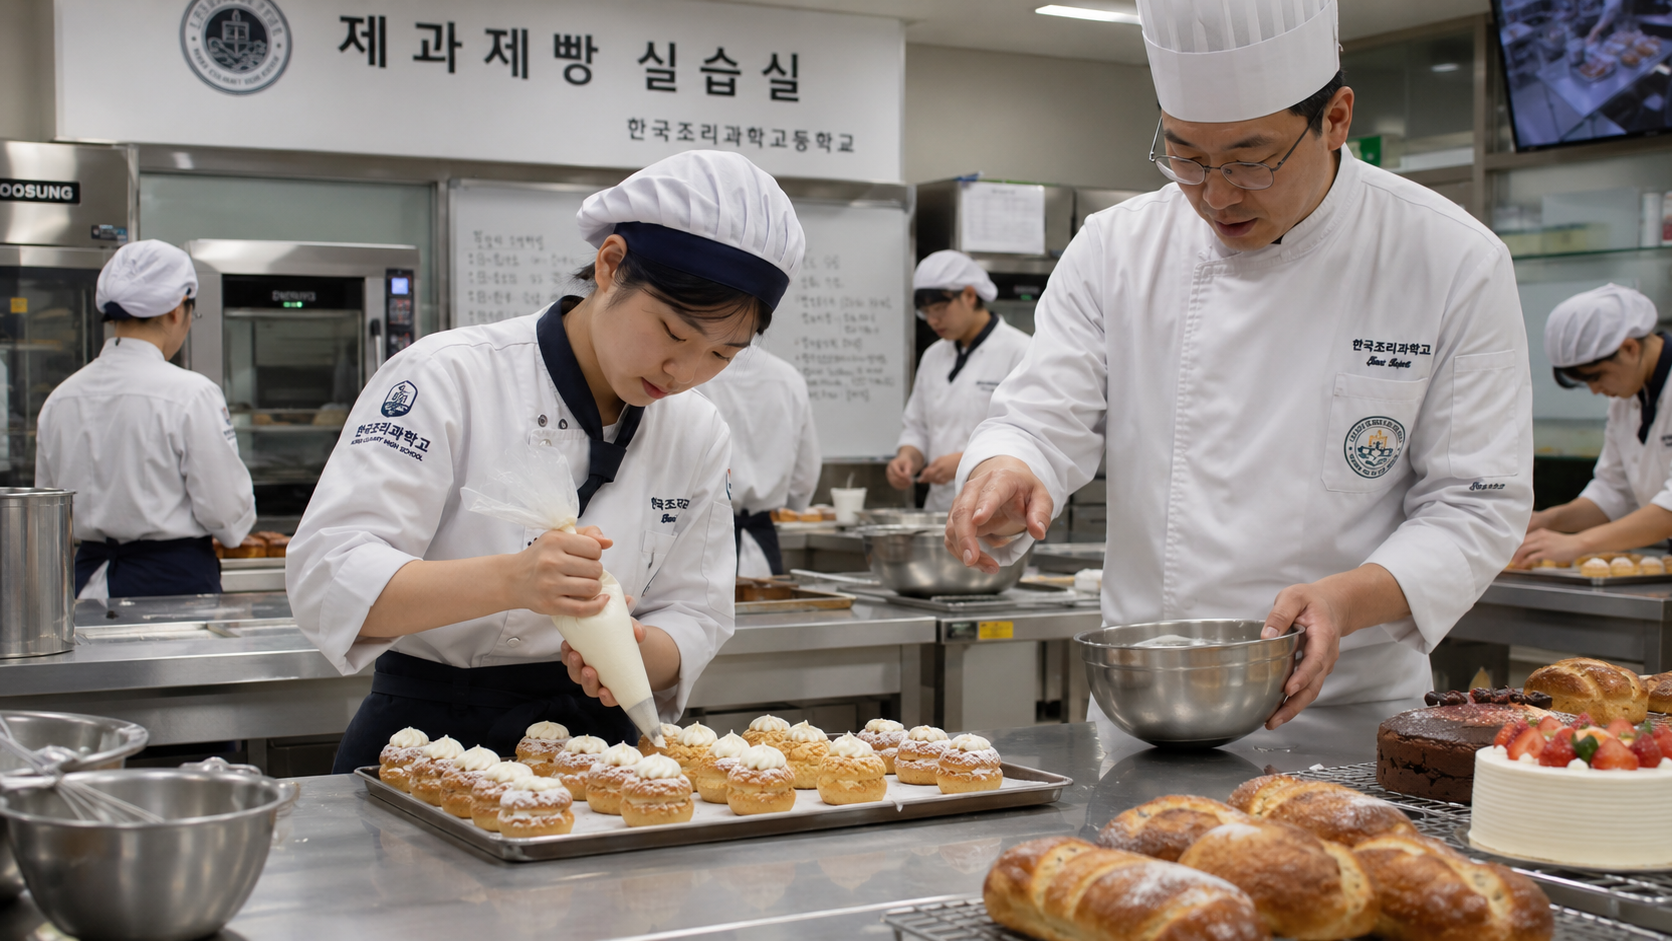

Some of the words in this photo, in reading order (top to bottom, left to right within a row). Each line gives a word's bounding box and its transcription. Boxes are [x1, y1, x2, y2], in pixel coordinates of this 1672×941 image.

[338, 13, 600, 87] 제과제빵
[637, 39, 802, 103] 실습실
[627, 116, 856, 154] 한국조리과학고등학교
[0, 183, 73, 201] OOSUNG
[1353, 339, 1431, 355] 한국조리과학고
